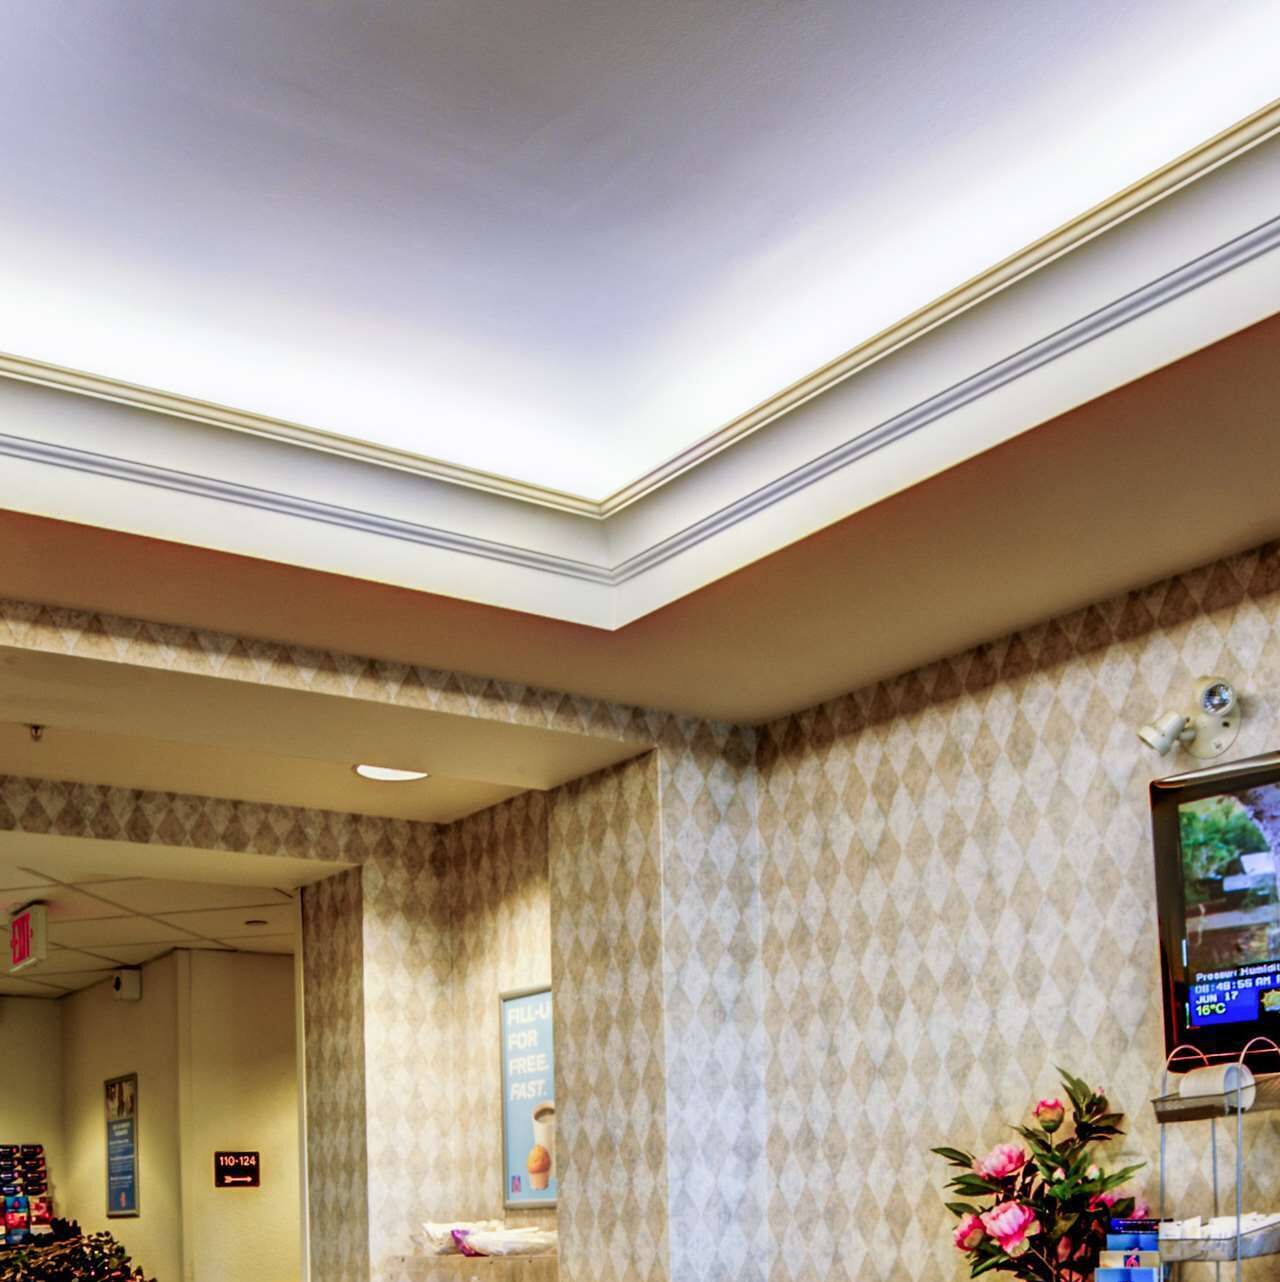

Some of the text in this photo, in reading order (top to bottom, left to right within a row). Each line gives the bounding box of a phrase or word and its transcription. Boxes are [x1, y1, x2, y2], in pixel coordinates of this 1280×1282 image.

[10, 912, 31, 966] EXIT
[1195, 990, 1239, 1005] JUN 17
[508, 1029, 539, 1050] FOR
[510, 1079, 548, 1101] FAST.
[219, 1155, 257, 1167] 110-124
